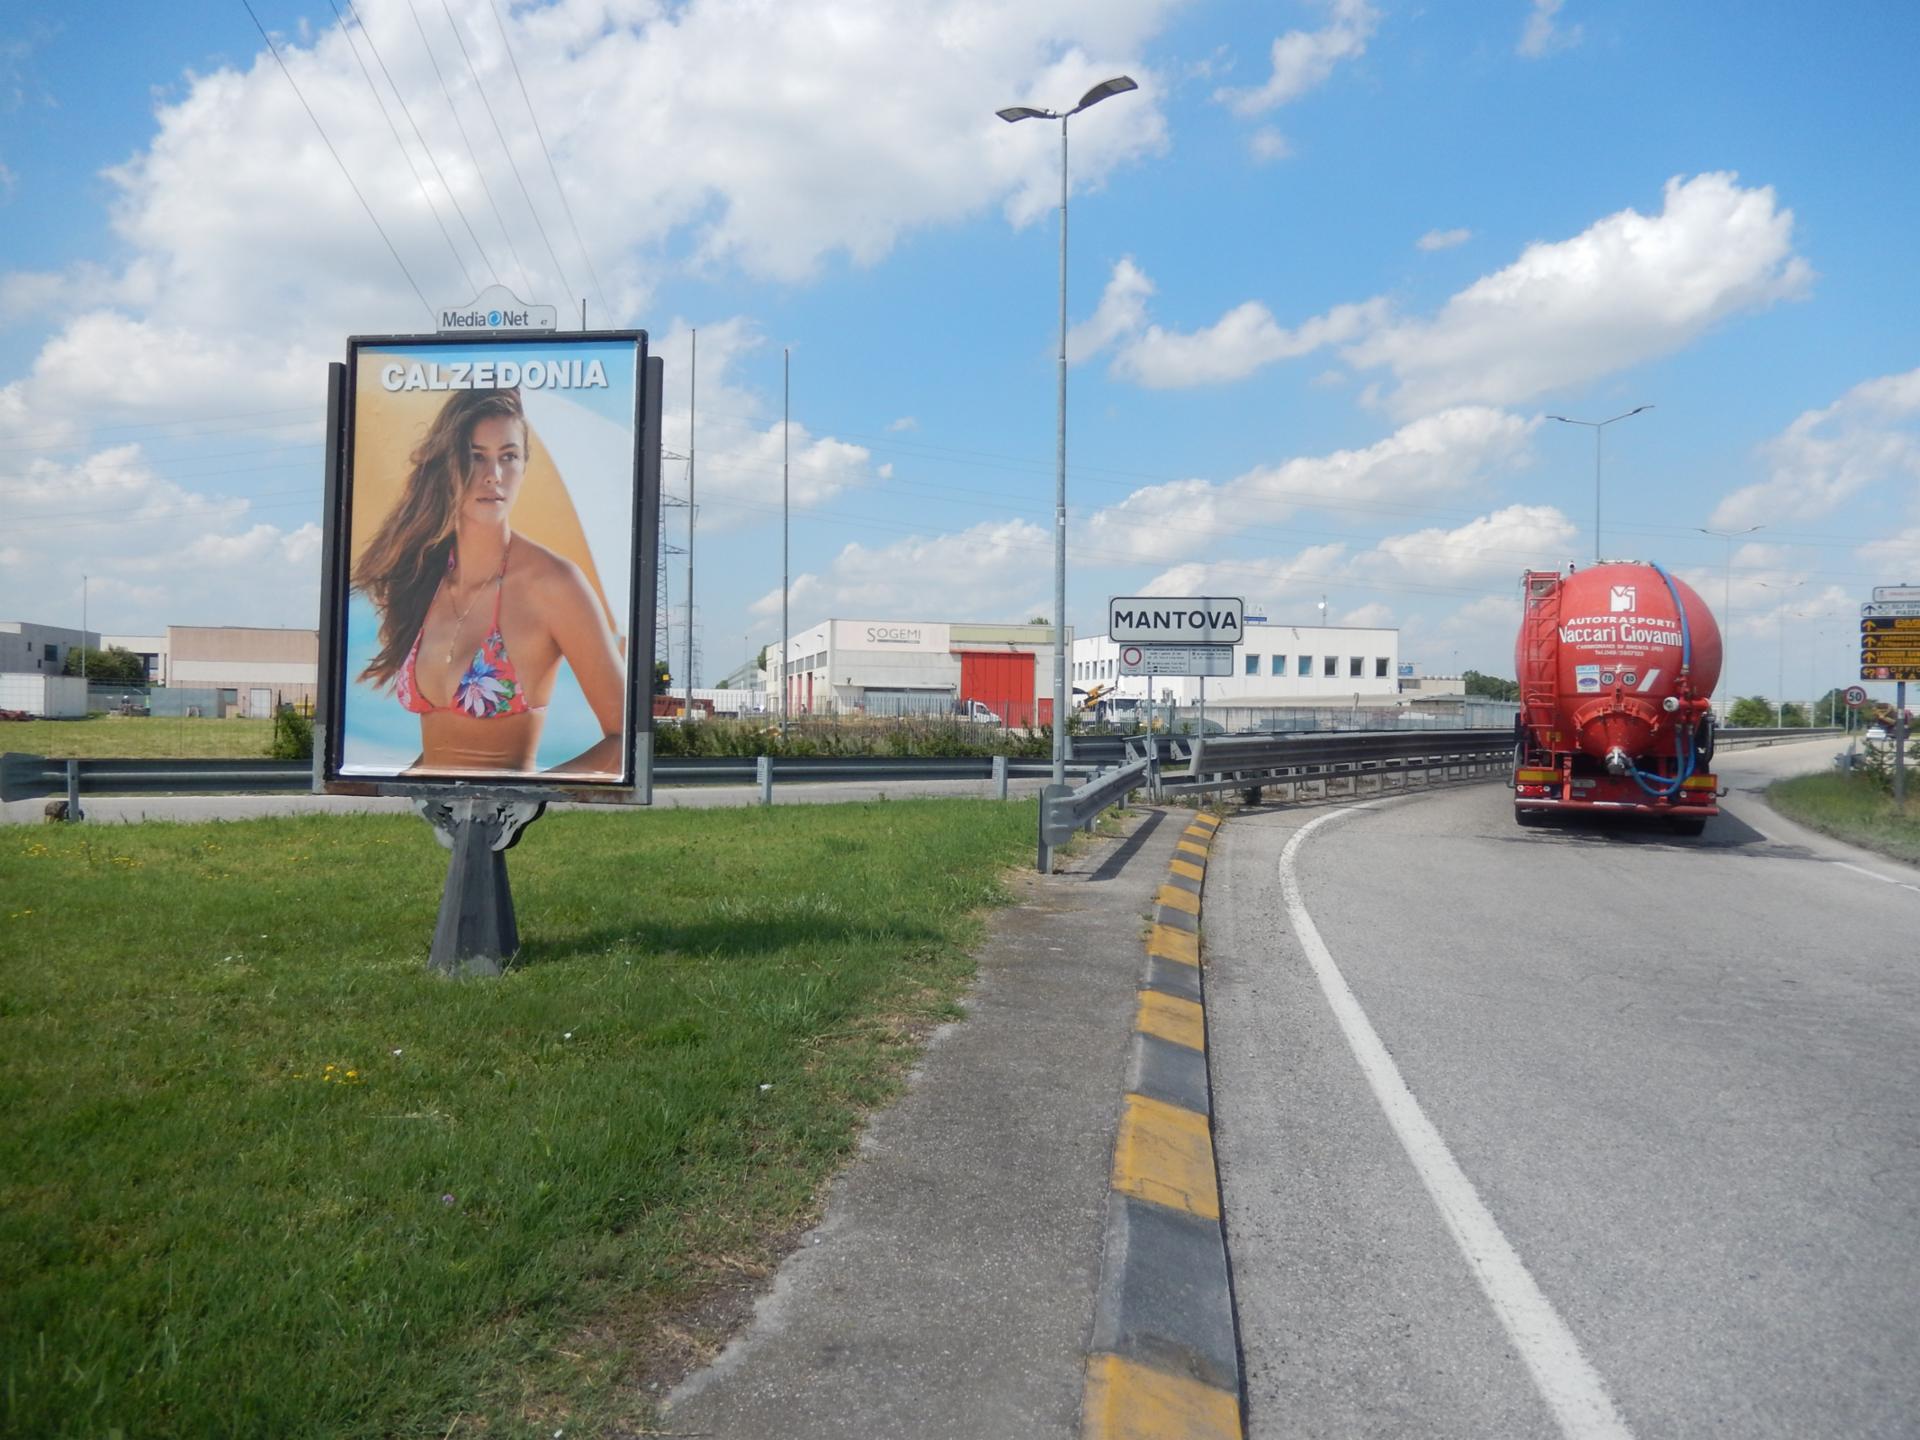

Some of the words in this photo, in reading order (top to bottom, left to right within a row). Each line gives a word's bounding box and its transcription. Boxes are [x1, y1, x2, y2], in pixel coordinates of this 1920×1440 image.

[443, 311, 486, 327] Media
[503, 310, 529, 326] Net
[382, 360, 608, 391] CALZEDONIA
[1115, 611, 1237, 629] MANTOVA
[1567, 616, 1676, 628] AUTOTRASPORTI
[867, 627, 920, 643] SOGEMI
[1559, 625, 1617, 643] Vaccari
[1620, 624, 1683, 647] Giovanni
[1849, 691, 1862, 703] 50
